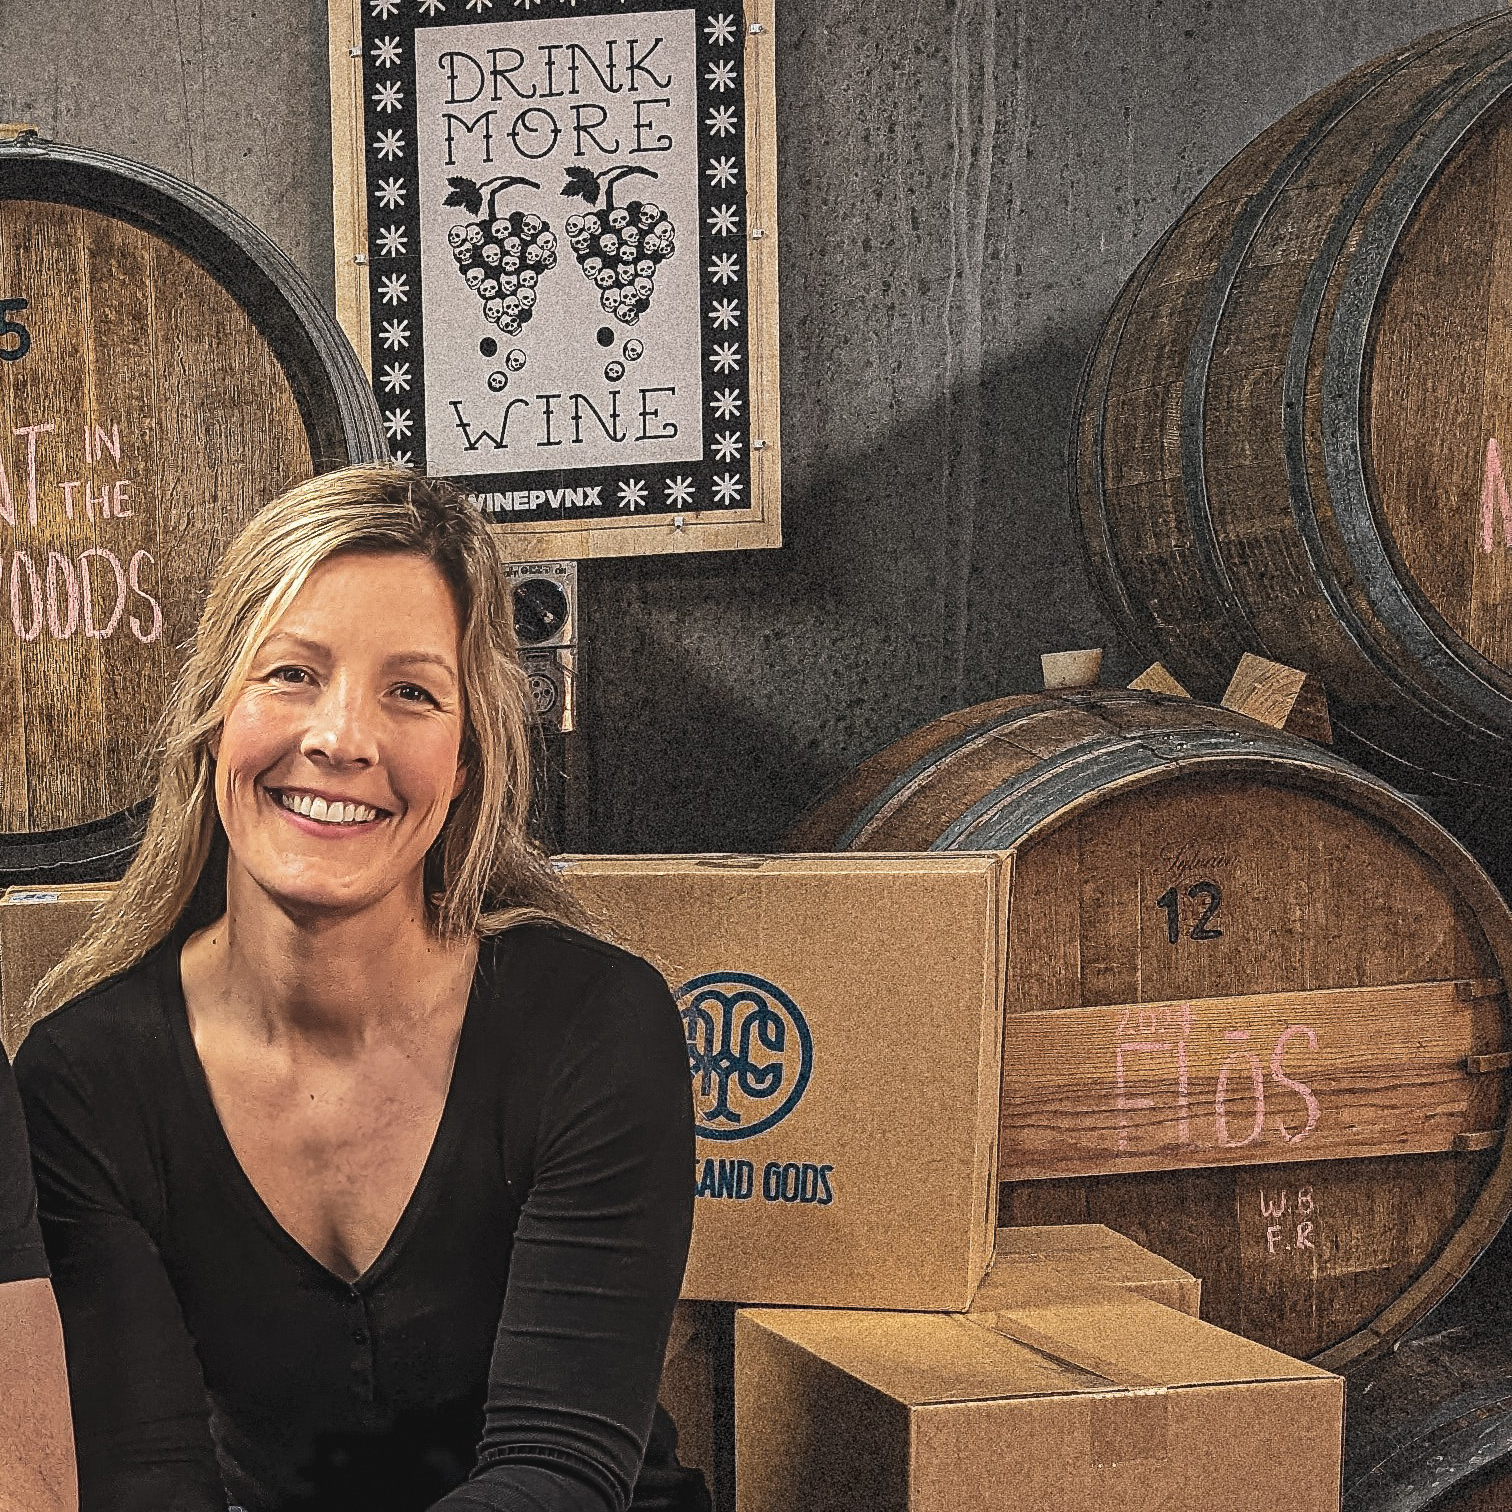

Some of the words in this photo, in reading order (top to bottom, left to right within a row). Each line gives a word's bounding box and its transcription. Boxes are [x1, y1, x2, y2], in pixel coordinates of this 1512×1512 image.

[438, 37, 673, 104] DRINK
[442, 97, 674, 166] MORE
[84, 423, 121, 466] IN
[448, 386, 679, 452] WINE
[58, 479, 136, 523] THE
[1156, 881, 1225, 945] 12
[762, 1161, 835, 1206] GODS
